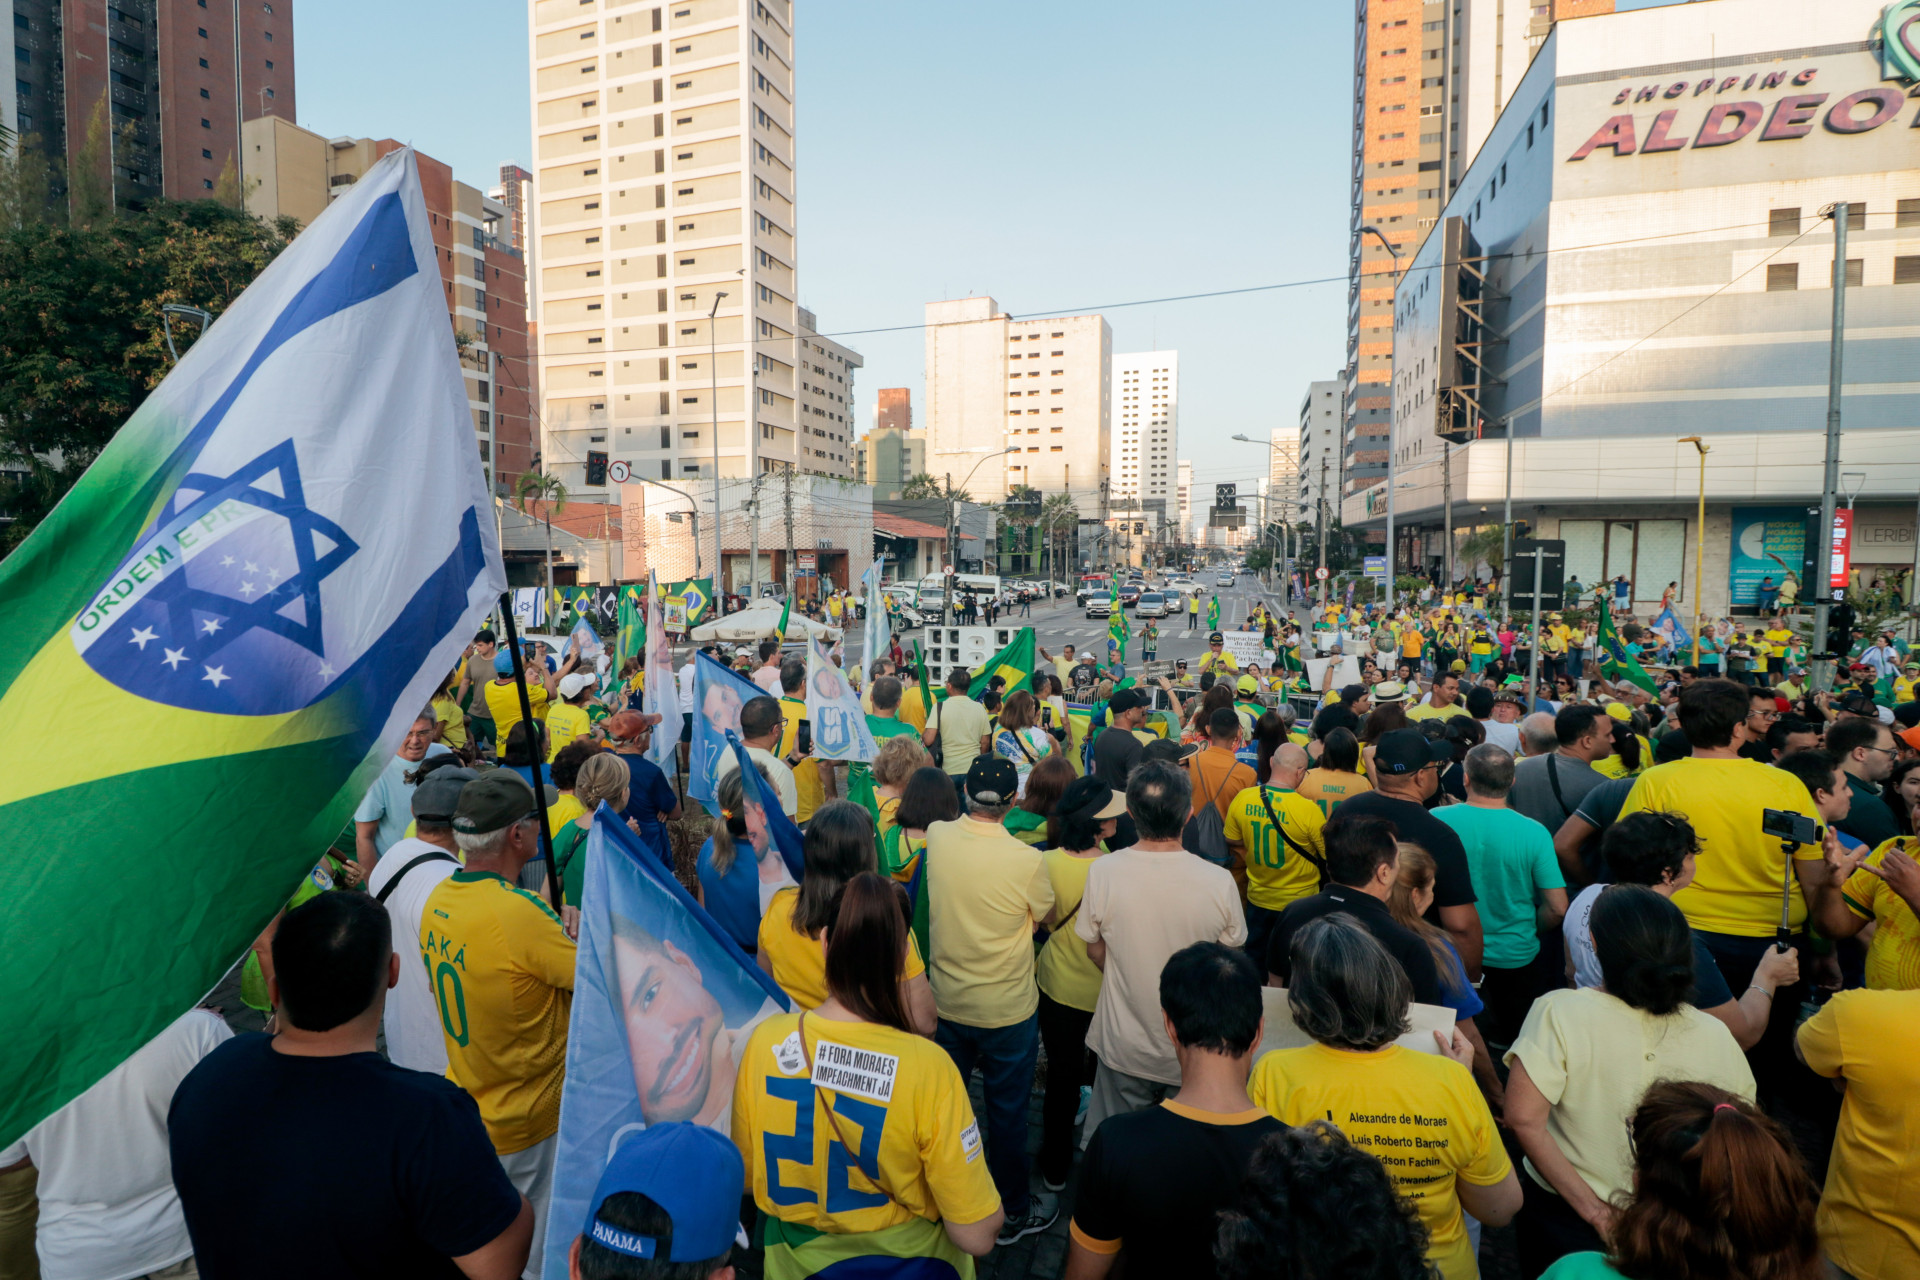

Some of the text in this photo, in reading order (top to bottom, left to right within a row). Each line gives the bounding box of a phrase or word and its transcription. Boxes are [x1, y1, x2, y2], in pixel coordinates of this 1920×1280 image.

[1612, 68, 1819, 105] SHOPPING
[1566, 84, 1920, 162] ALDEO
[78, 544, 175, 632] ORDEM
[172, 526, 199, 549] E
[1322, 784, 1346, 794] DINIZ
[1250, 820, 1285, 869] 10
[419, 929, 467, 971] AKÁ
[827, 1046, 852, 1067] FORA
[853, 1051, 896, 1077] MORAES
[815, 1065, 891, 1098] IMPEACHMENT JÁ
[1349, 1112, 1448, 1127] Alexandre de Moraes
[762, 1075, 890, 1214] 22
[1351, 1134, 1373, 1146] Luis
[1374, 1135, 1413, 1147] Roberto
[1408, 1157, 1440, 1167] Fachin
[592, 1221, 643, 1254] PANAMA
